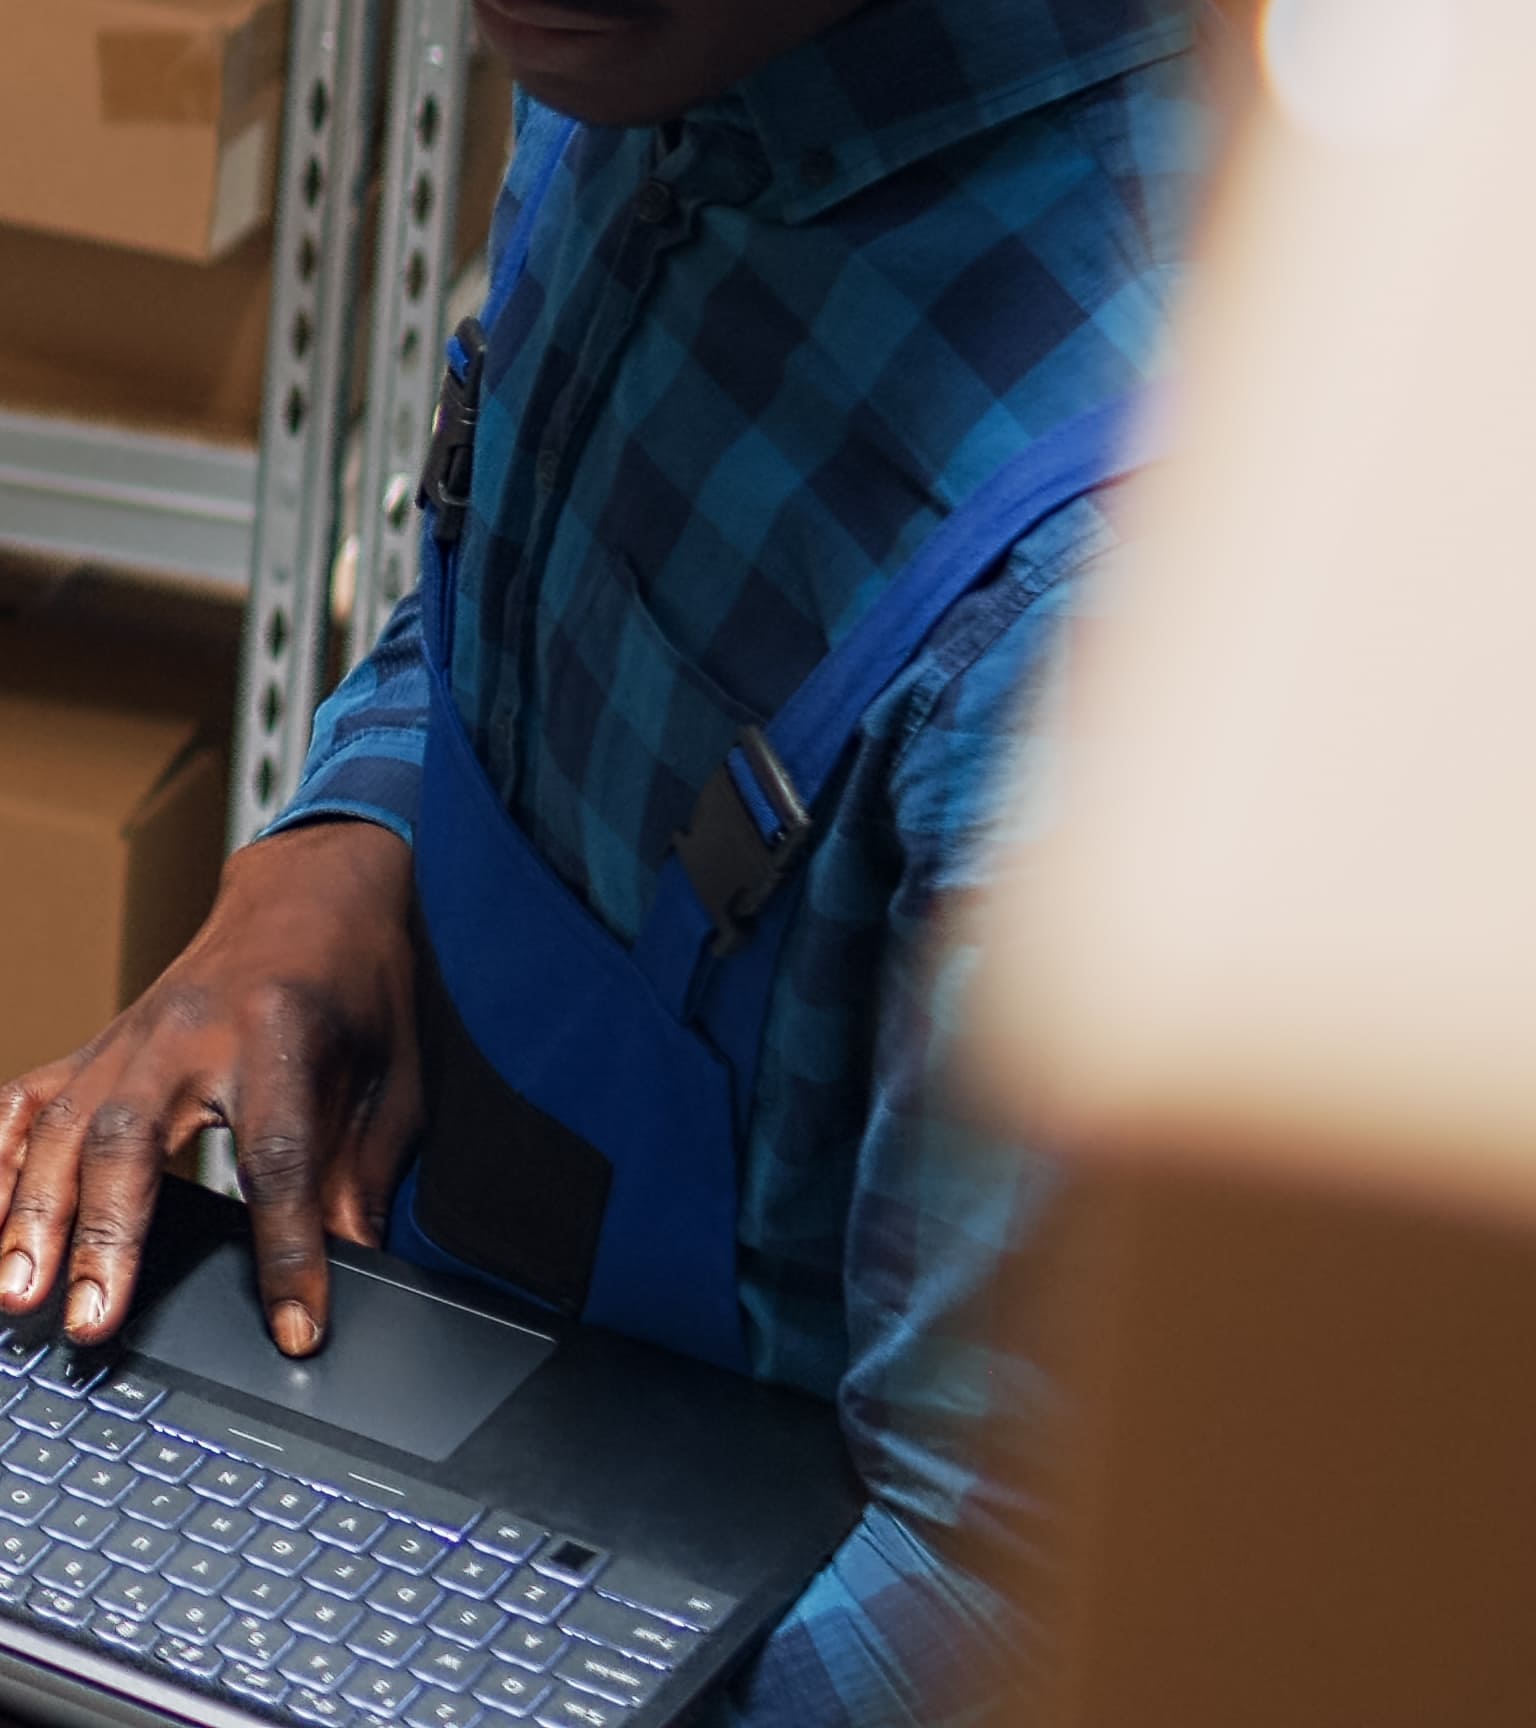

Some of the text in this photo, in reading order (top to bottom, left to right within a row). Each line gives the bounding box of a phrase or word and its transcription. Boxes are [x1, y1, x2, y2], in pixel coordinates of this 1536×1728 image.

[38, 1449, 49, 1462] L
[159, 1448, 178, 1462] M
[92, 1472, 110, 1485] K
[218, 1472, 237, 1485] N
[12, 1490, 30, 1503] O
[152, 1496, 169, 1505] J
[280, 1494, 298, 1507] B
[75, 1515, 87, 1527] I
[212, 1518, 231, 1531] H
[339, 1518, 356, 1531] V
[4, 1538, 22, 1551] 9
[132, 1537, 150, 1550] U
[272, 1541, 293, 1554] G
[401, 1540, 419, 1553] C
[65, 1562, 82, 1575] 8
[192, 1561, 208, 1574] Y
[335, 1566, 354, 1577] F
[464, 1562, 483, 1577] X
[125, 1586, 142, 1599] 7
[253, 1584, 269, 1597] T
[398, 1588, 416, 1601] D
[525, 1586, 546, 1600] Z
[186, 1608, 204, 1622] 6
[316, 1607, 335, 1621] R
[460, 1611, 477, 1624] S
[248, 1632, 265, 1646] 5
[378, 1630, 397, 1645] E
[525, 1634, 542, 1648] A
[311, 1656, 328, 1667] 4
[435, 1654, 461, 1670] W
[373, 1680, 390, 1693] 3
[502, 1678, 524, 1693] Q
[436, 1704, 455, 1718] 2
